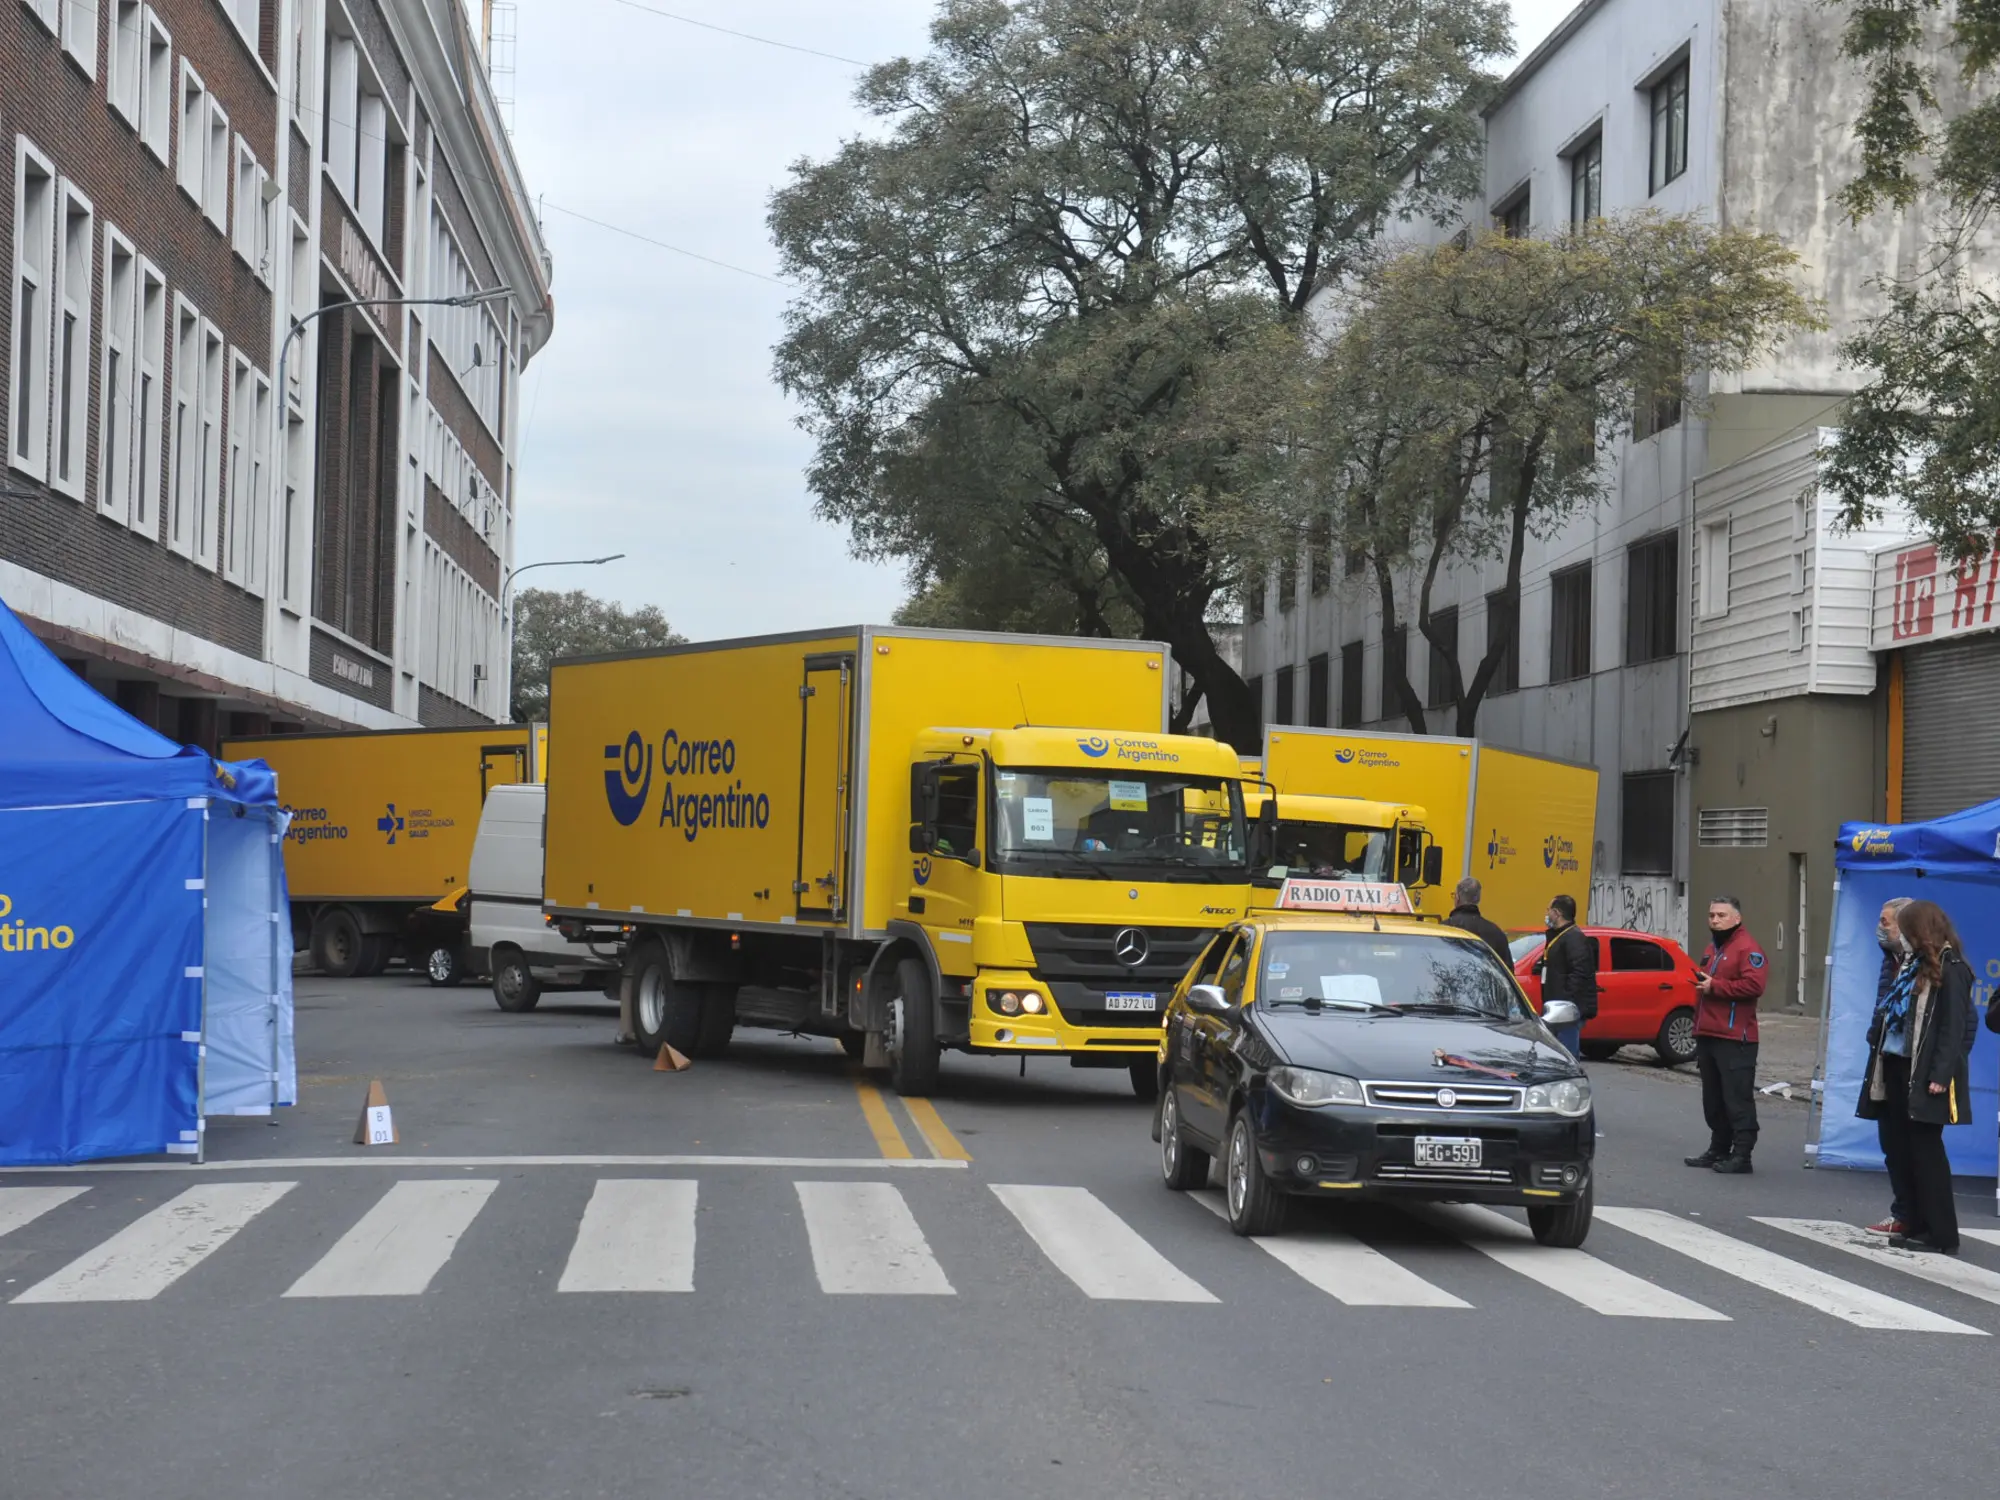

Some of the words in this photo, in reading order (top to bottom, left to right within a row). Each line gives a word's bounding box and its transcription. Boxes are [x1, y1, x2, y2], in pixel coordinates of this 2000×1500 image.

[1113, 737, 1158, 749] Correo
[661, 728, 736, 776] Correo
[1117, 745, 1180, 763] Argentino
[1357, 748, 1388, 758] Correo
[1357, 757, 1400, 768] Argentino
[659, 778, 770, 843] Argentino
[1290, 886, 1341, 903] RADIO
[1345, 888, 1382, 904] TAXI
[1108, 998, 1120, 1009] AD
[1122, 998, 1140, 1009] 372
[374, 1130, 388, 1142] 01
[1416, 1144, 1444, 1162] MEG
[1452, 1145, 1479, 1162] 591
